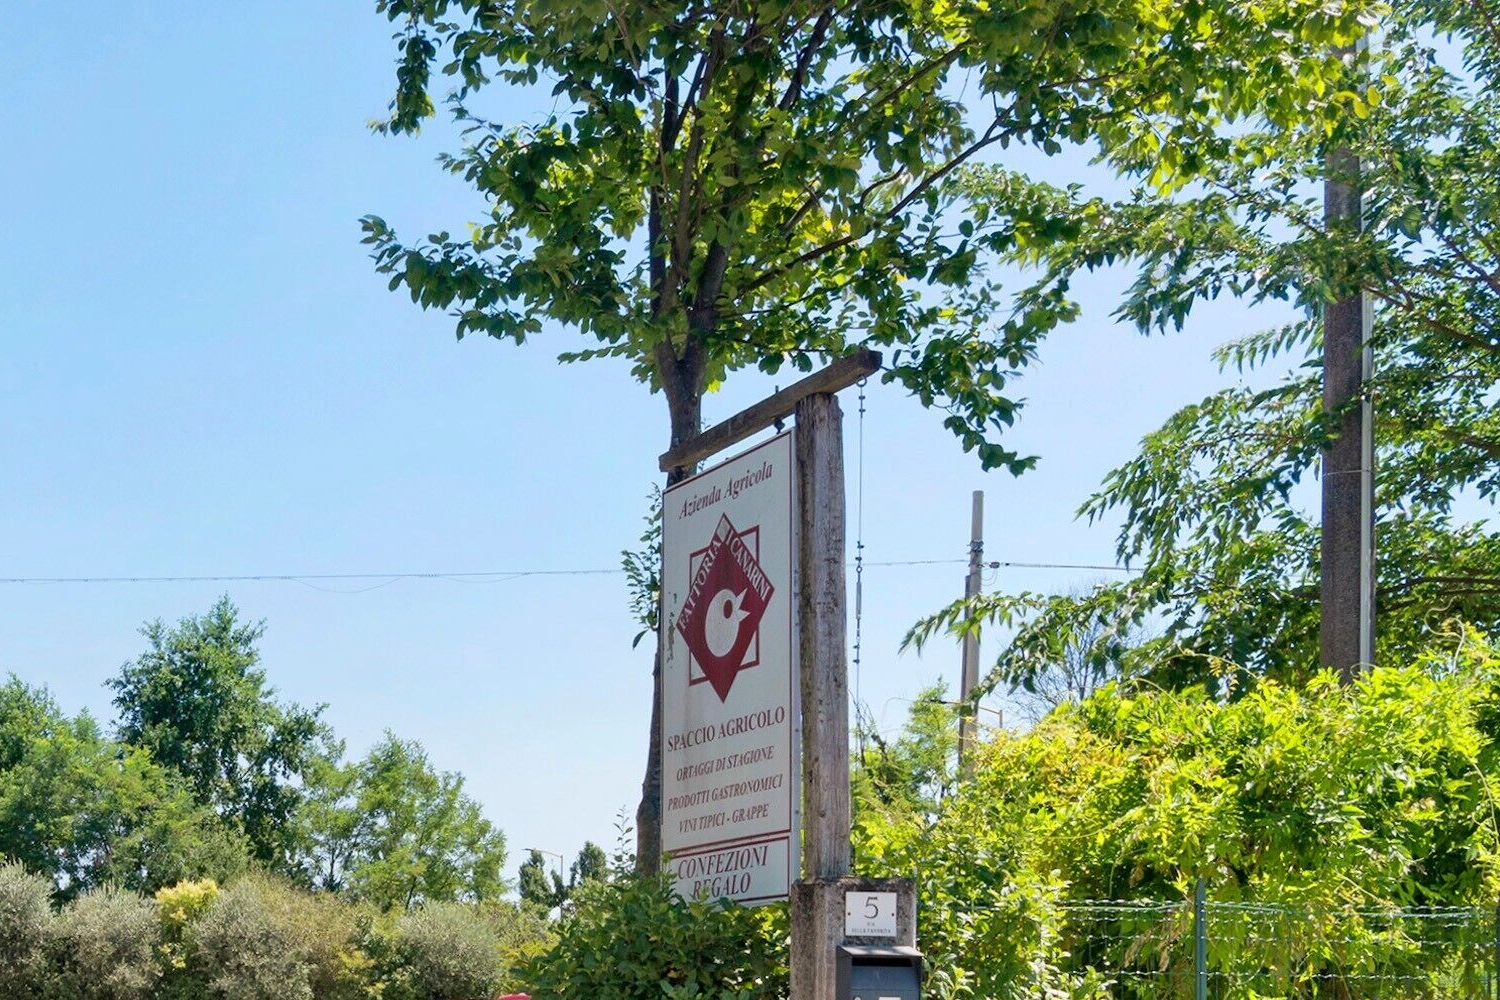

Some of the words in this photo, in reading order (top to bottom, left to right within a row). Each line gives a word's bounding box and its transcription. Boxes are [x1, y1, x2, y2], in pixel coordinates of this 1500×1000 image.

[679, 485, 721, 519] Azienda
[724, 461, 773, 499] Agricola
[680, 540, 722, 629] FATTORIA
[731, 537, 771, 602] CANARINI
[667, 725, 715, 752] SPACCIO
[718, 706, 785, 739] AGRICOLO
[676, 760, 714, 781] ORTAGGI
[716, 758, 727, 771] DI
[727, 746, 774, 769] STAGIONE
[668, 789, 711, 811] PRODOTTI
[711, 774, 783, 801] GASTRONOMICI
[679, 818, 697, 833] VINI
[699, 812, 725, 830] TIPICI
[732, 804, 769, 823] GRAPPE
[677, 846, 768, 880] CONFEZIONI
[864, 896, 879, 919] 5
